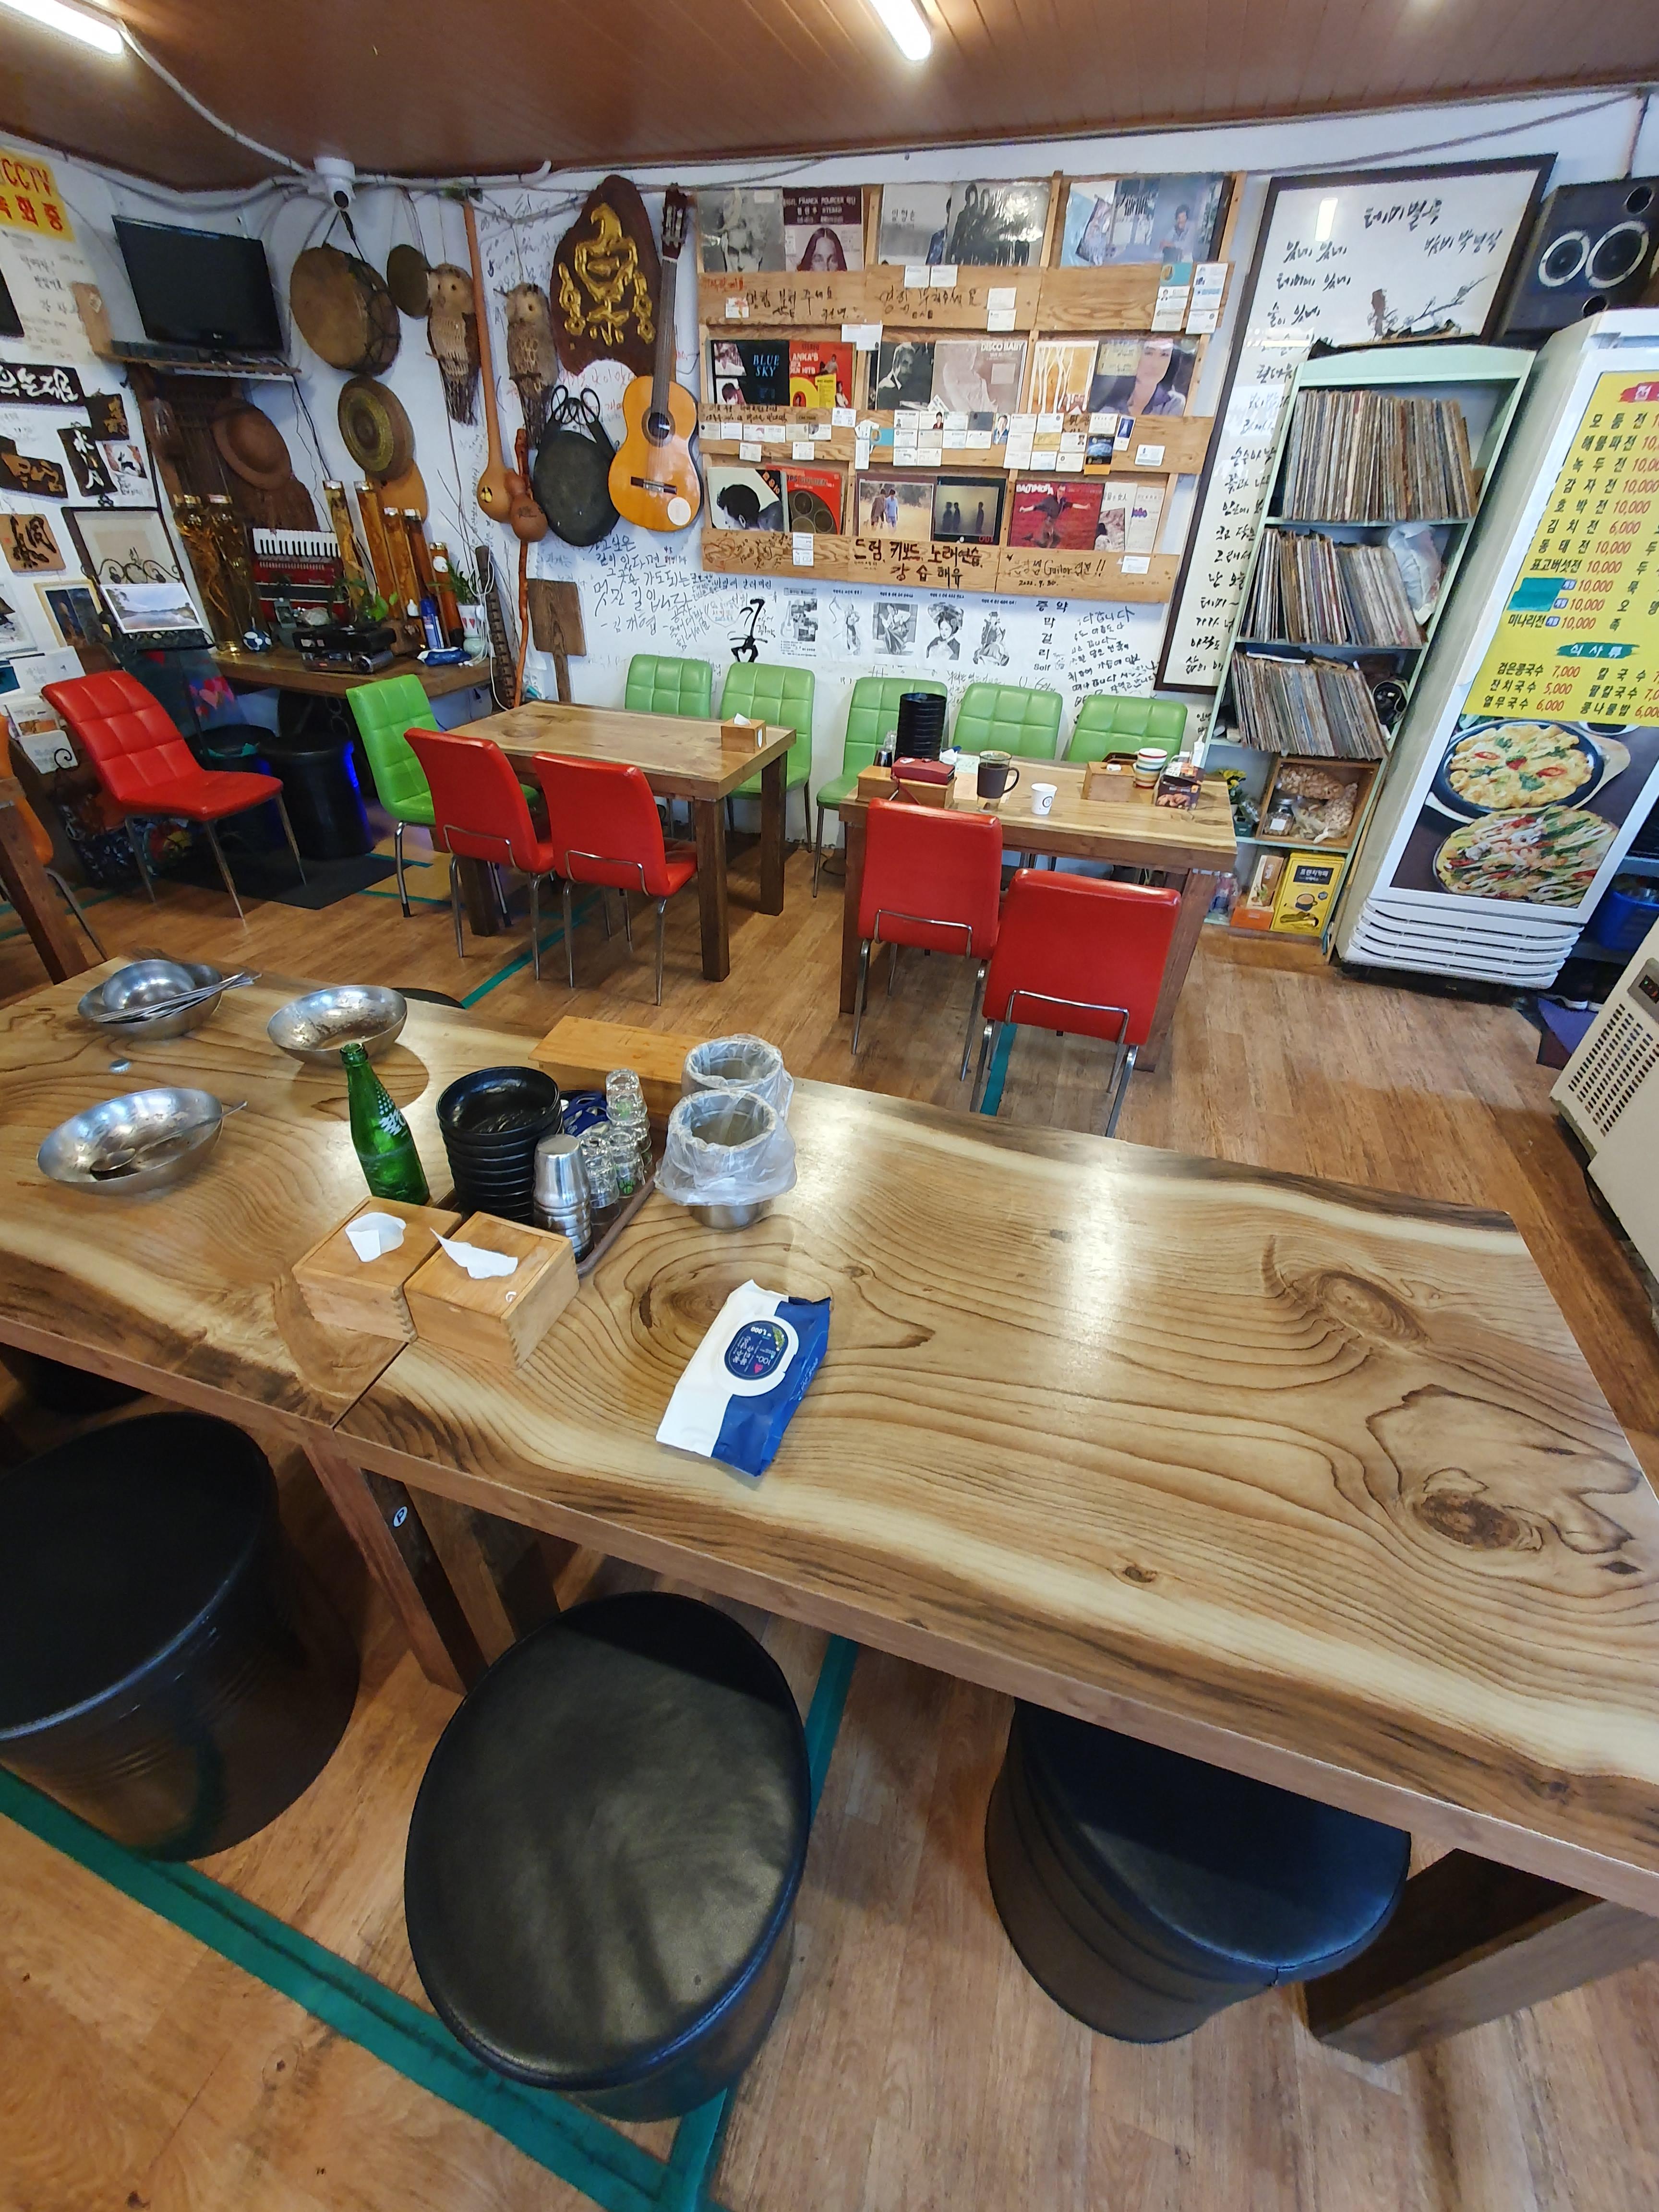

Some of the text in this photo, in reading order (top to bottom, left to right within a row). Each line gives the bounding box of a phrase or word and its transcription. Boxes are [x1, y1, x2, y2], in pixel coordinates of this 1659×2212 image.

[1, 158, 51, 196] CCTV
[753, 354, 780, 366] BLUE
[756, 366, 776, 377] SKY
[1581, 435, 1637, 451] 해물파전
[1563, 478, 1659, 495] 감자전 10,000
[1613, 500, 1651, 515] 10,000
[1547, 519, 1641, 536] 김치전 6,000
[1538, 539, 1591, 554] 동태전
[1595, 540, 1632, 556] 10,000
[1529, 558, 1583, 574] 표고버섯전
[1586, 560, 1623, 575] 10,000
[1577, 579, 1613, 594] 10,000
[1570, 598, 1605, 612] 10,000
[1508, 614, 1546, 628] 미나리전
[1561, 616, 1596, 630] 10,000
[1497, 662, 1544, 677] 검은콩국수
[1551, 665, 1581, 678] 7,000
[1490, 679, 1536, 693] 잔치국수
[1543, 682, 1573, 695] 5,000
[1483, 695, 1528, 710] 열무국수
[1536, 699, 1564, 712] 6,000
[1580, 702, 1630, 717] 콩나물밥
